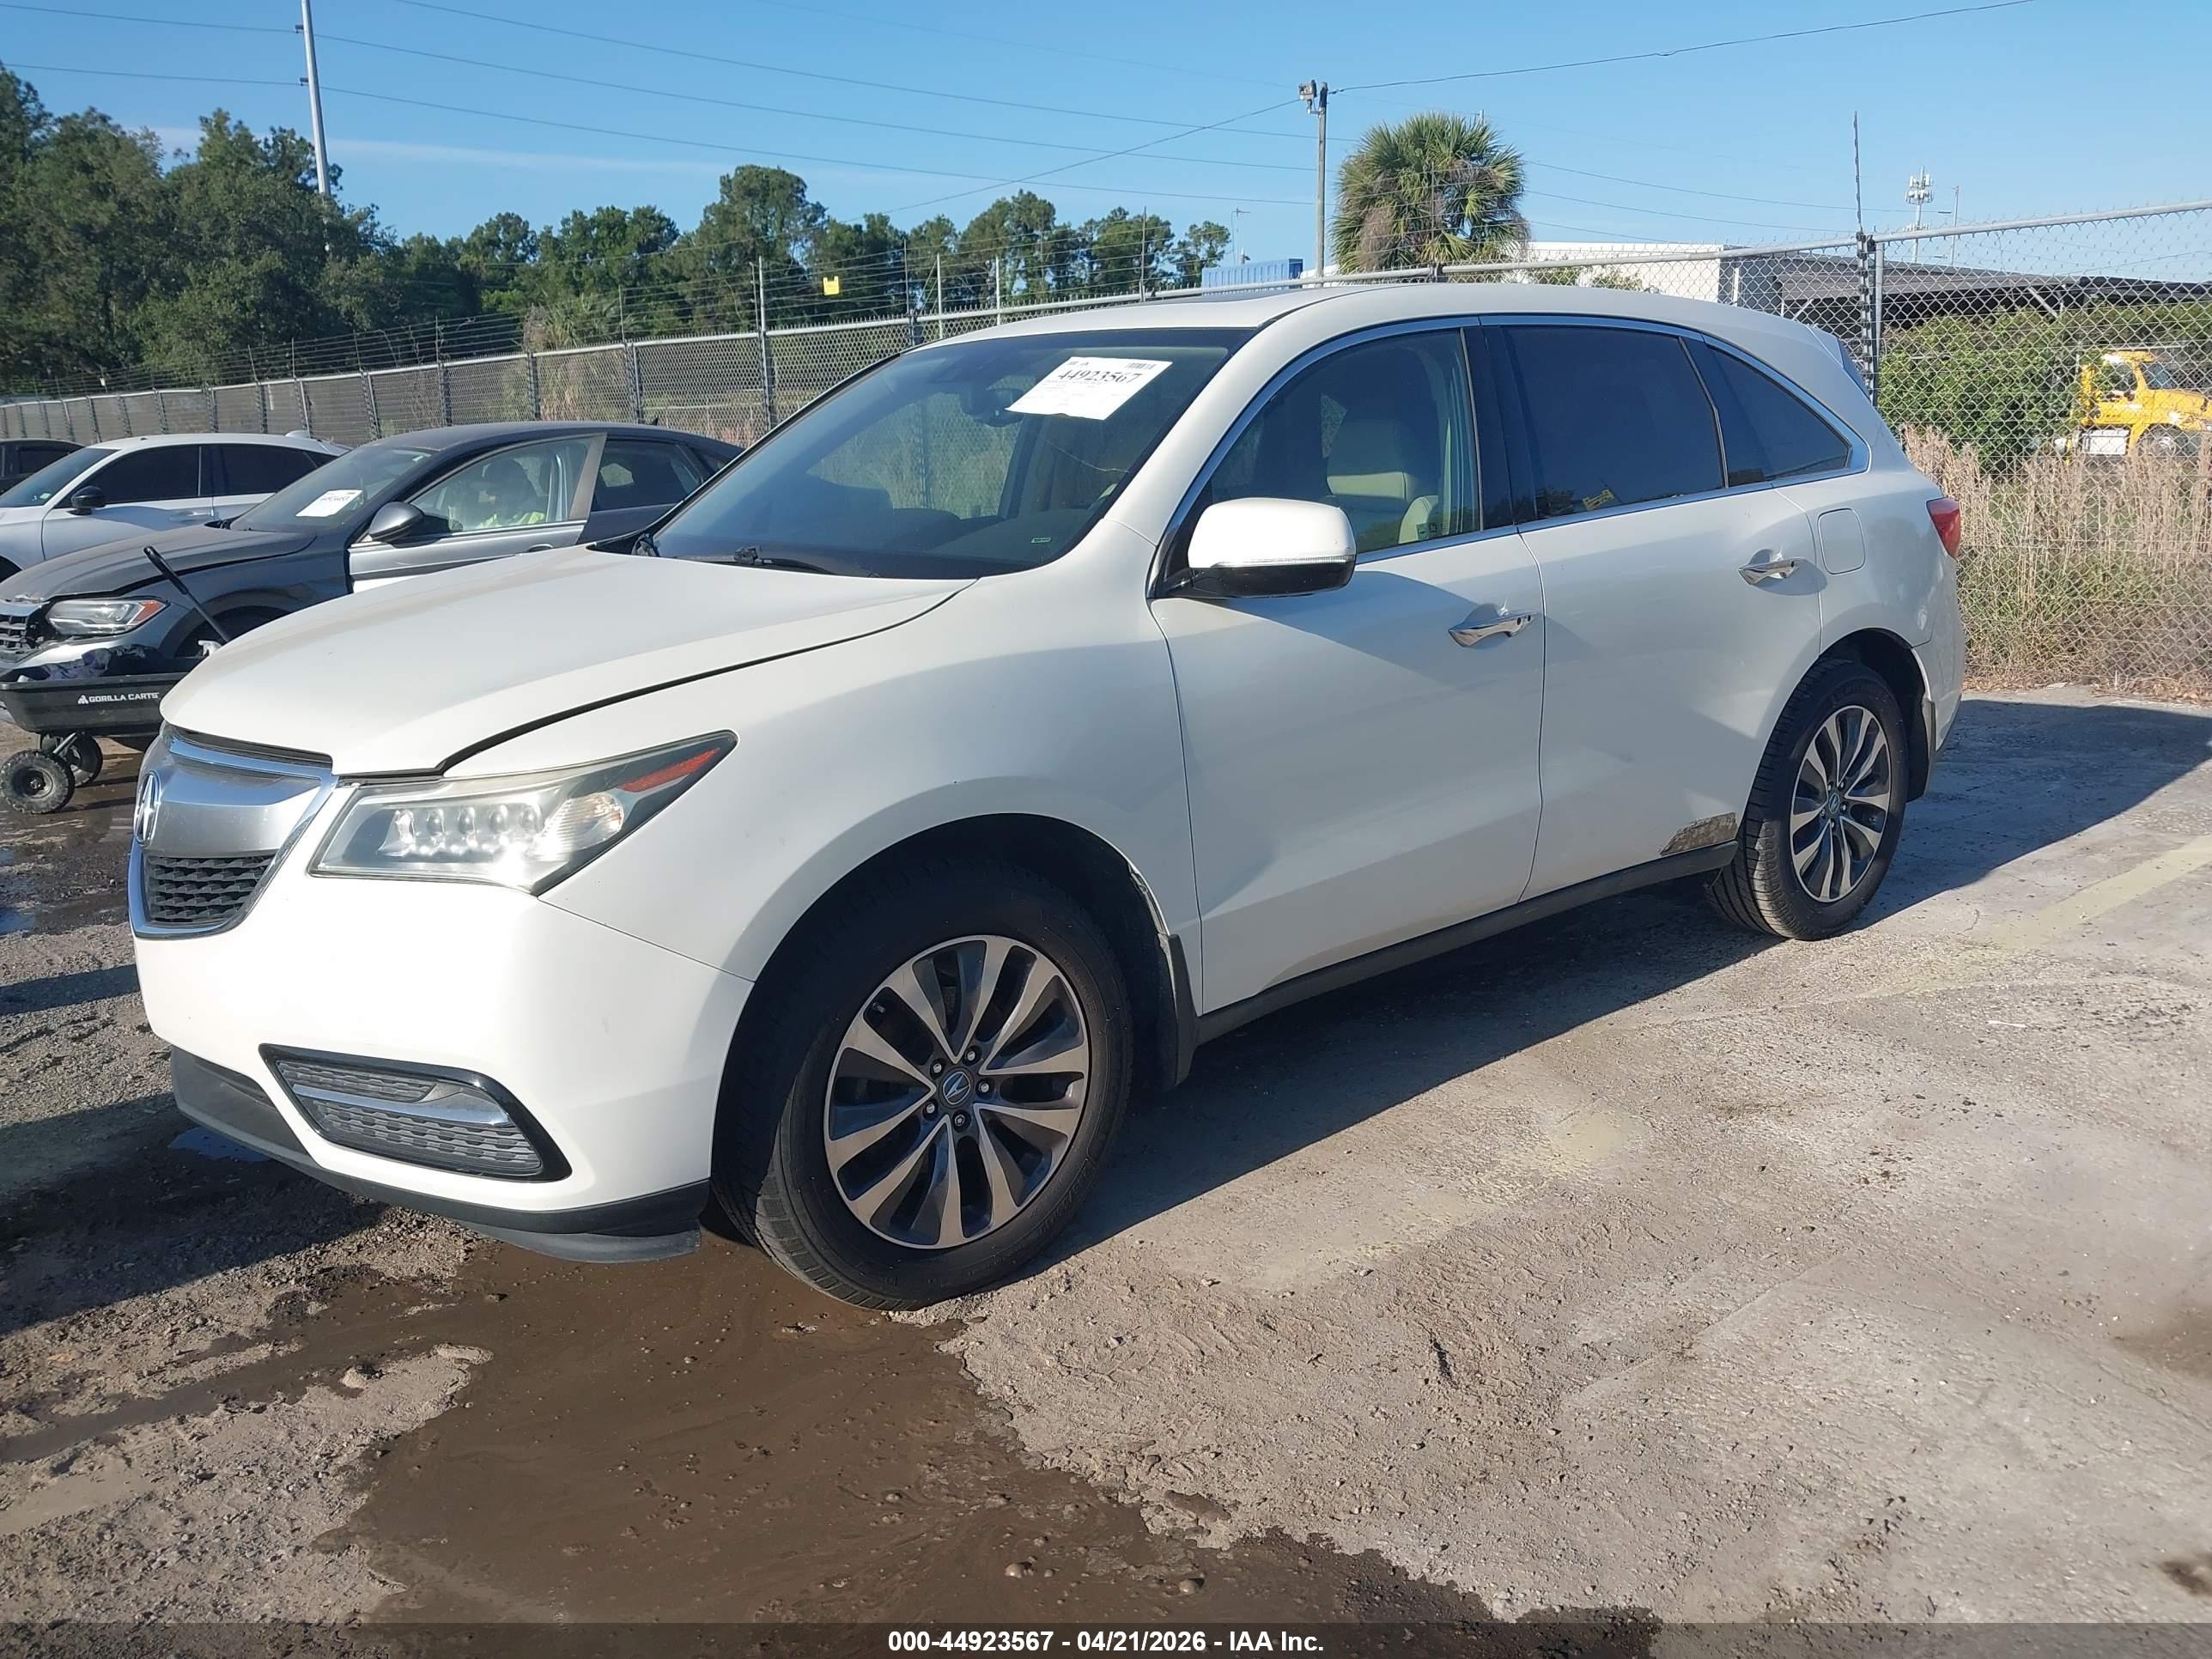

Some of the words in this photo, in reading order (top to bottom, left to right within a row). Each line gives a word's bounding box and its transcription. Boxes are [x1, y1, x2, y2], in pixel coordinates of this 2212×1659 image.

[1057, 369, 1143, 384] 44923567
[88, 694, 127, 703] GORILLA
[127, 692, 159, 701] CARTS
